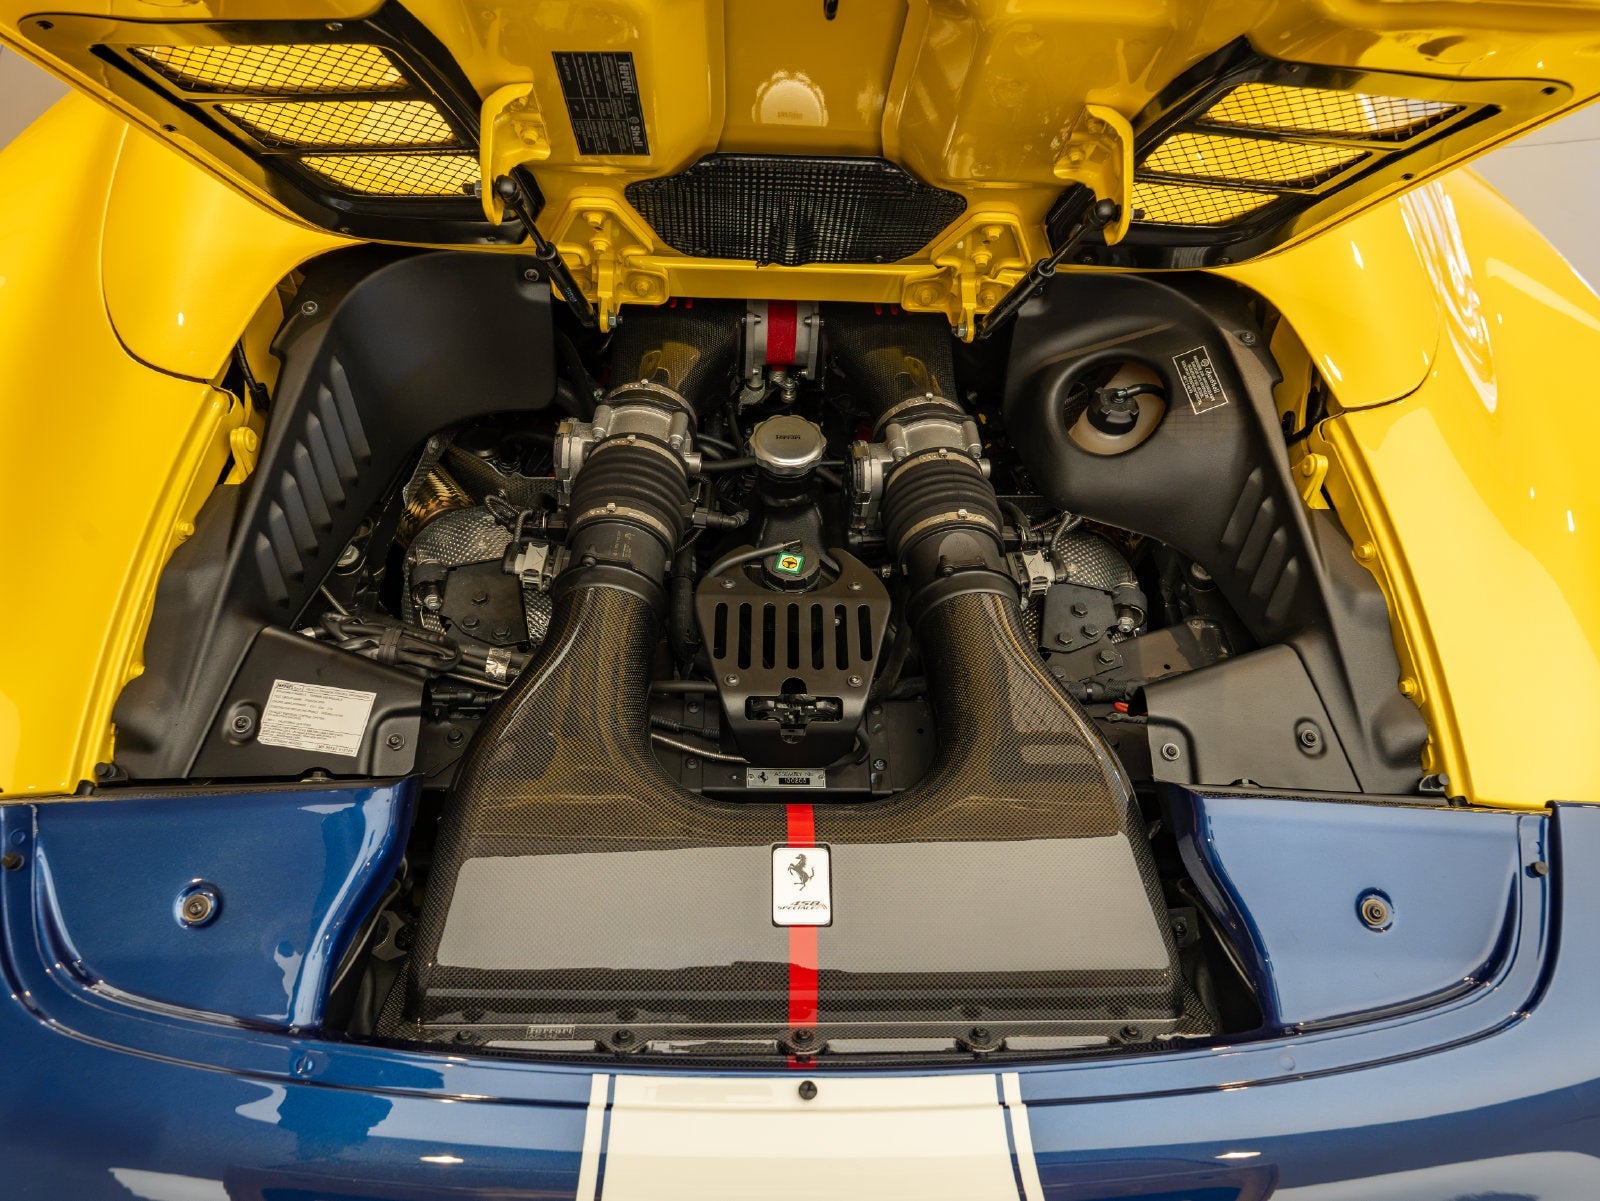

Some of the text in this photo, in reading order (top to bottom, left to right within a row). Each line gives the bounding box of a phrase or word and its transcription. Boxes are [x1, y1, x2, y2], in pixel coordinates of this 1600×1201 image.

[618, 61, 636, 94] Ferrari
[631, 125, 644, 147] Shell
[528, 1026, 574, 1035] Ferrari
